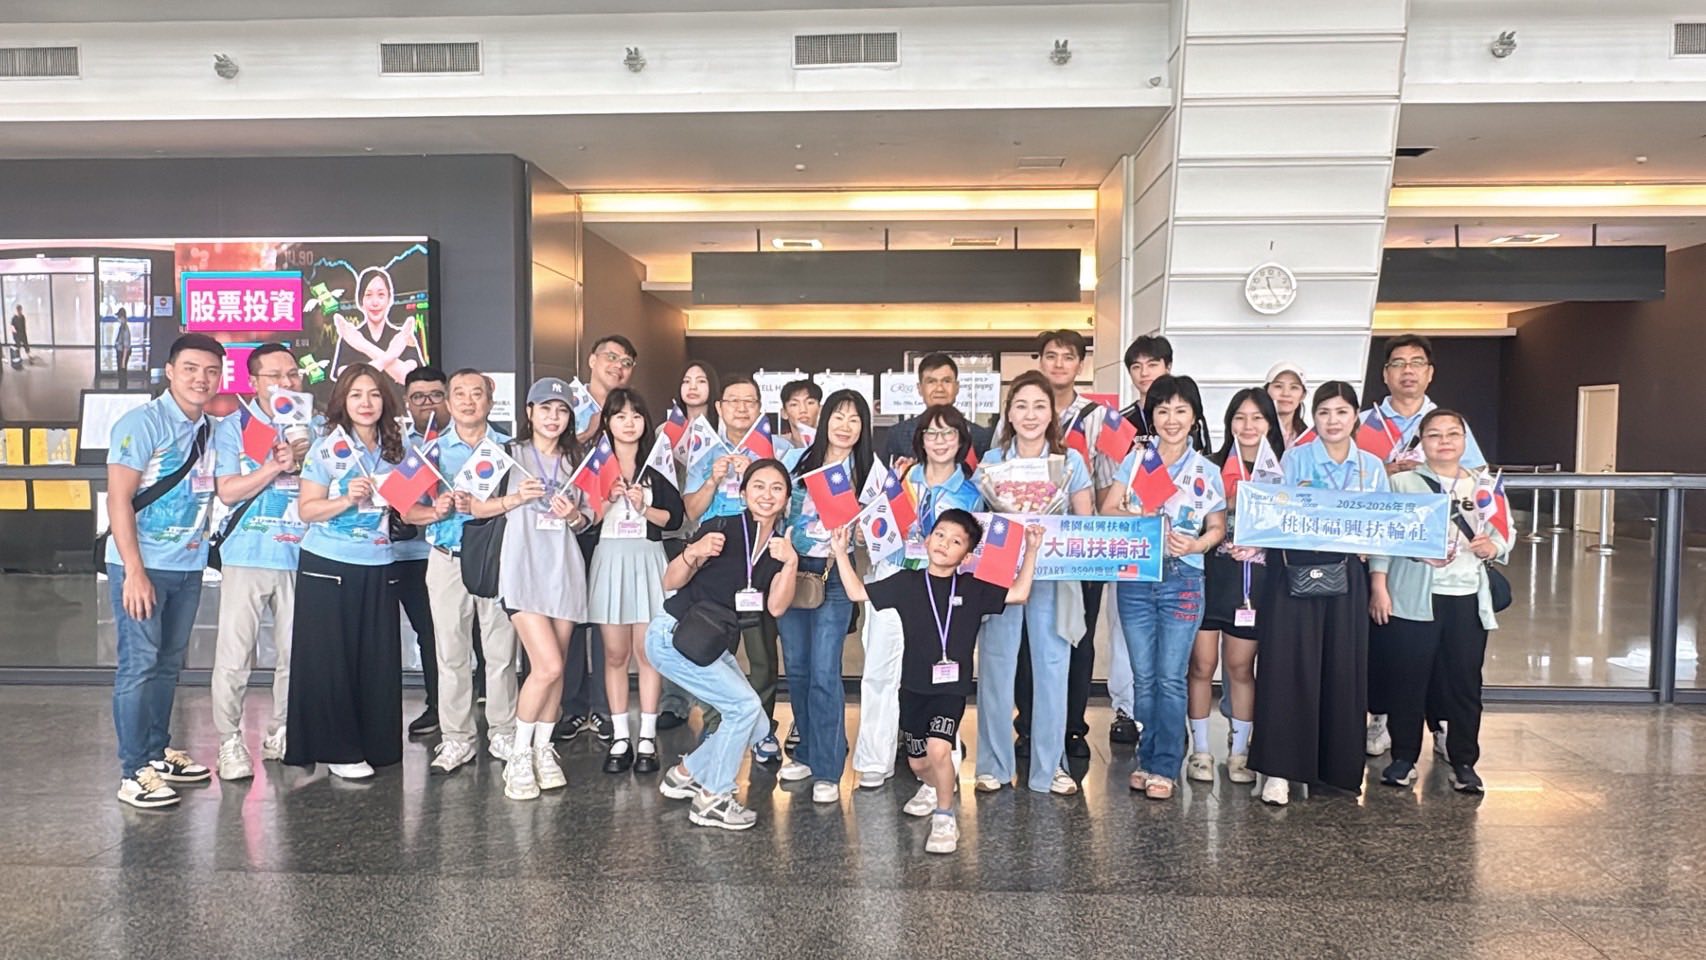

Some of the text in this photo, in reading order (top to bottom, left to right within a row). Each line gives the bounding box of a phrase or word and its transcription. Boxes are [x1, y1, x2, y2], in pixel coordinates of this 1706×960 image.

[190, 290, 296, 323] 股票投資
[1336, 500, 1417, 513] 2025-2026年度
[1281, 513, 1427, 541] 桃園福興扶輪社
